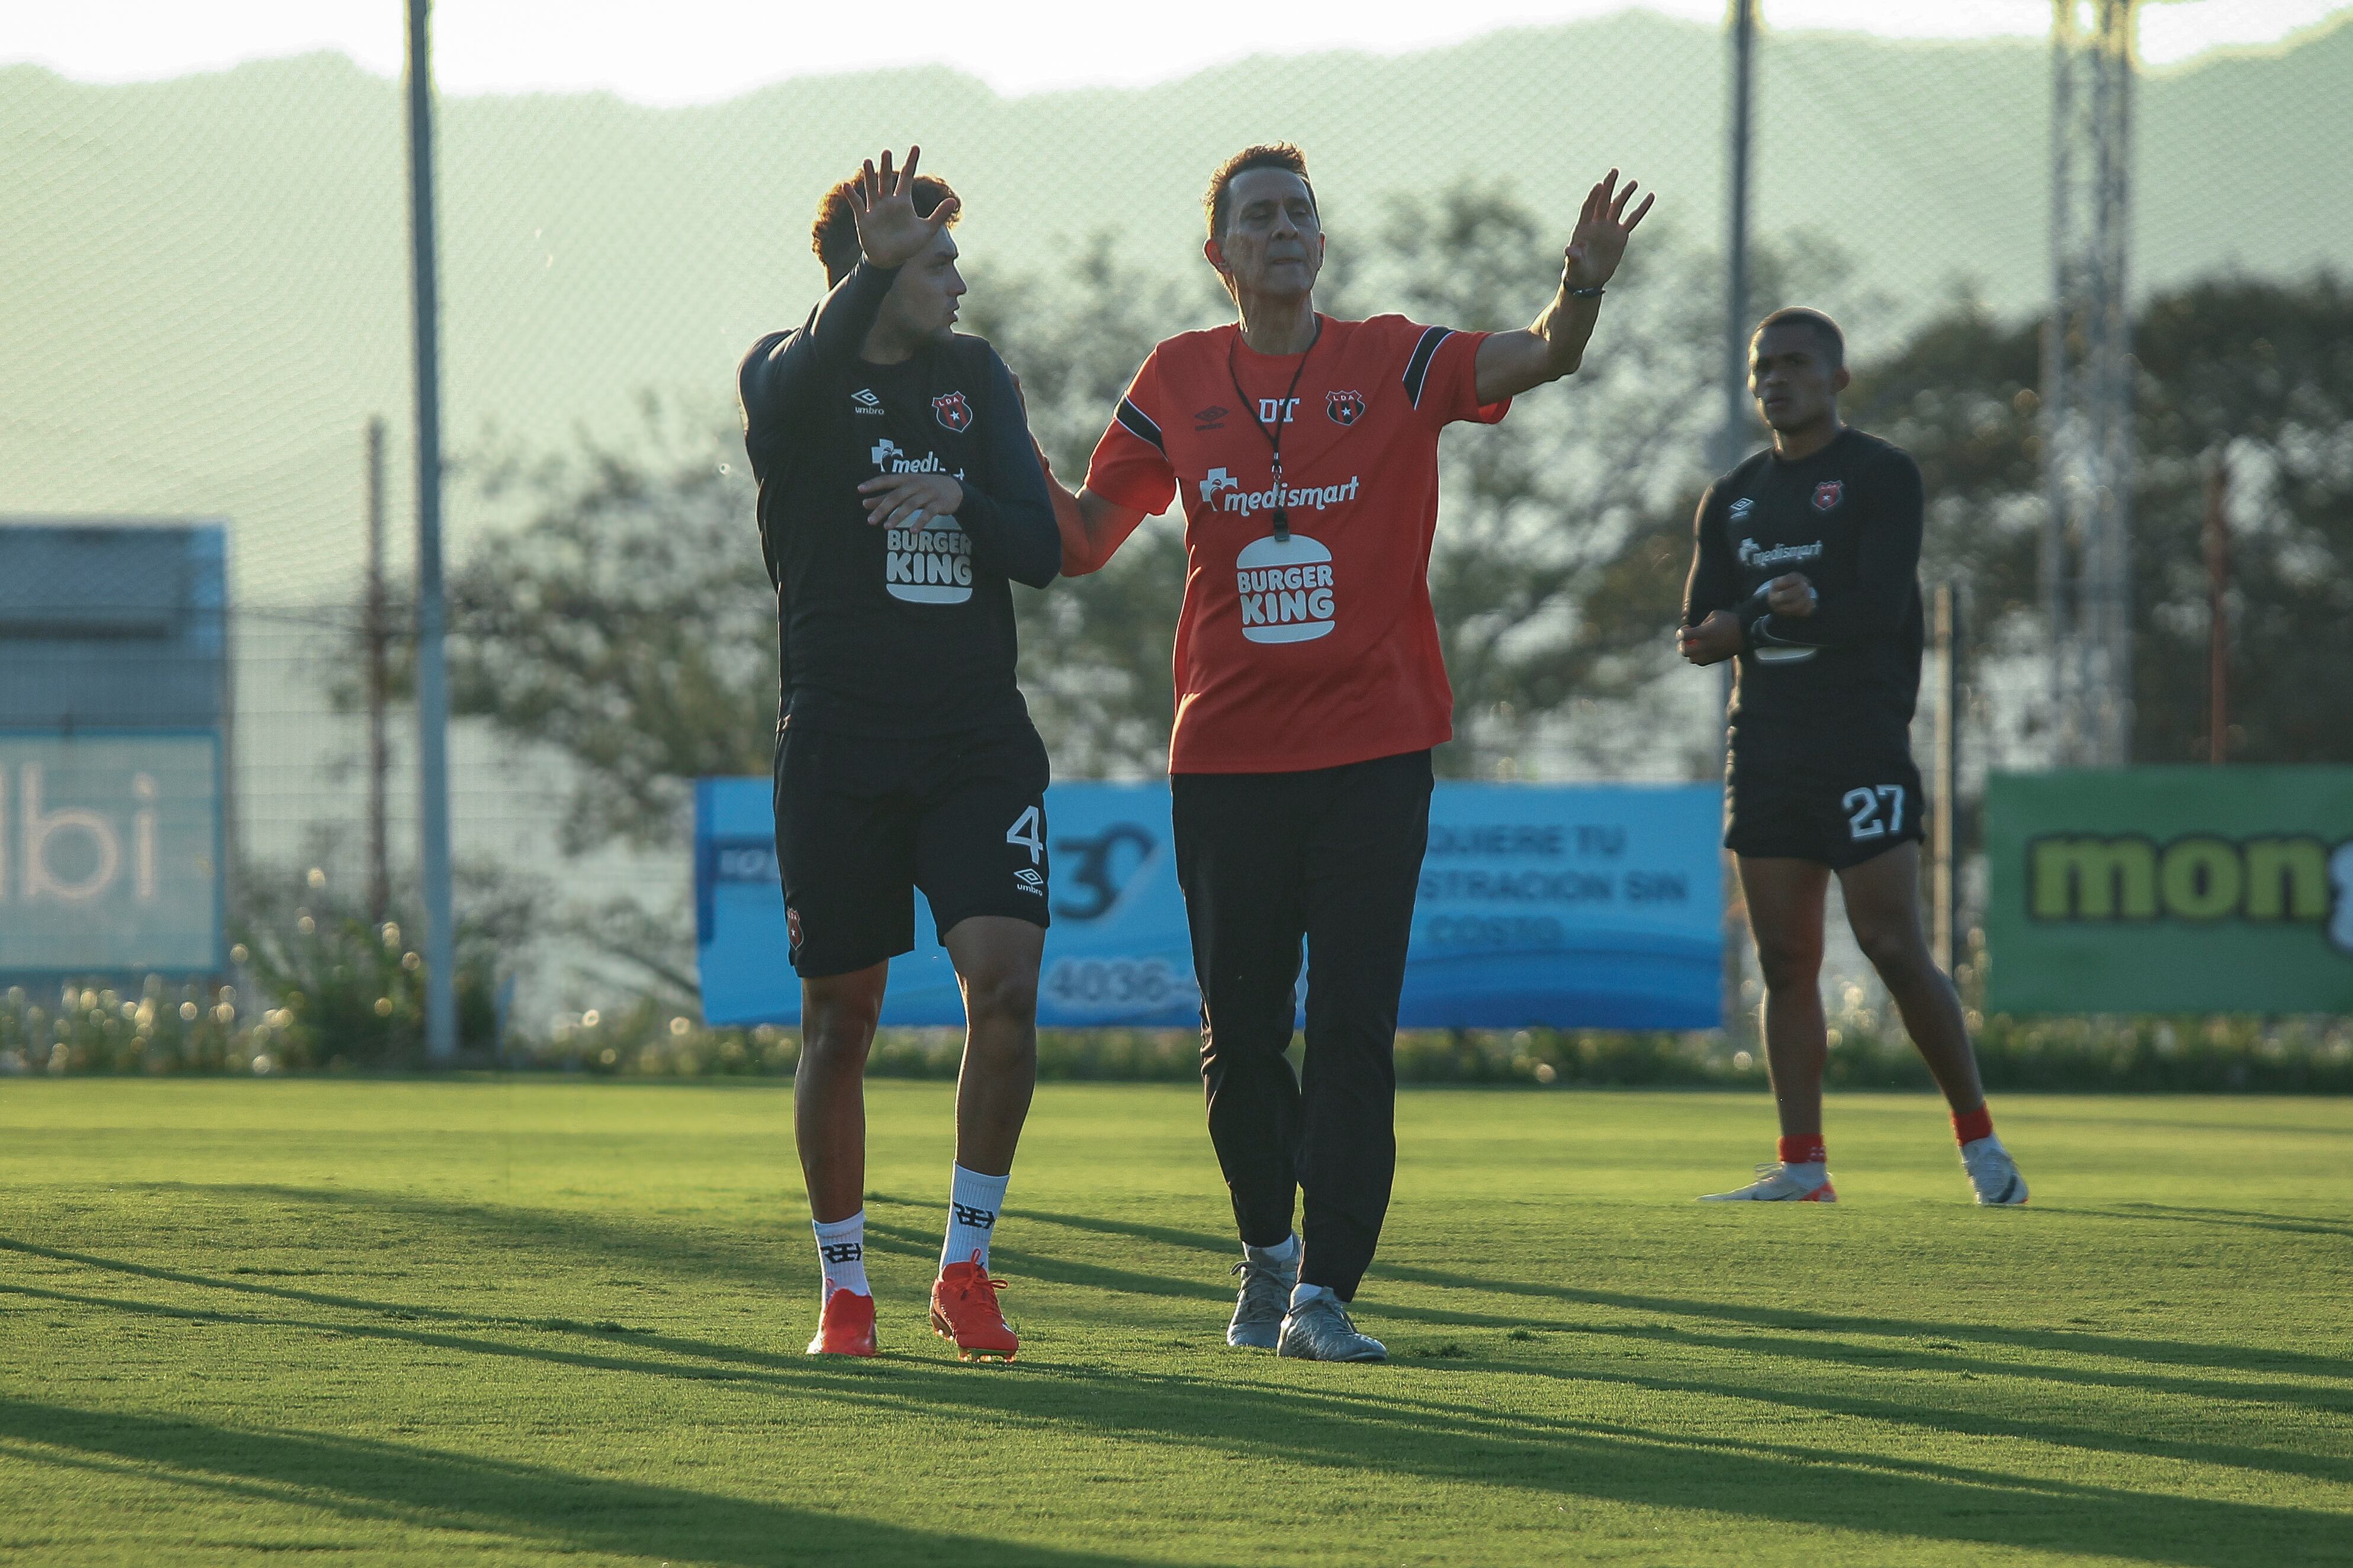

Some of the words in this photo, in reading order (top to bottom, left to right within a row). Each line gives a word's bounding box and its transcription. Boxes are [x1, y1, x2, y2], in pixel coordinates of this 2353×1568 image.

[855, 407, 884, 415] umbro
[938, 397, 959, 407] LDA
[1259, 398, 1300, 422] DT
[1224, 475, 1359, 516] medismart
[888, 530, 972, 554] BURGER
[1753, 540, 1822, 567] medismart
[887, 551, 972, 585] KING
[1237, 565, 1333, 593] BURGER
[1240, 588, 1335, 624] KING
[1843, 784, 1904, 839] 27
[1007, 806, 1043, 864] 4
[1017, 884, 1043, 896] umbro
[2030, 833, 2353, 952] mon
